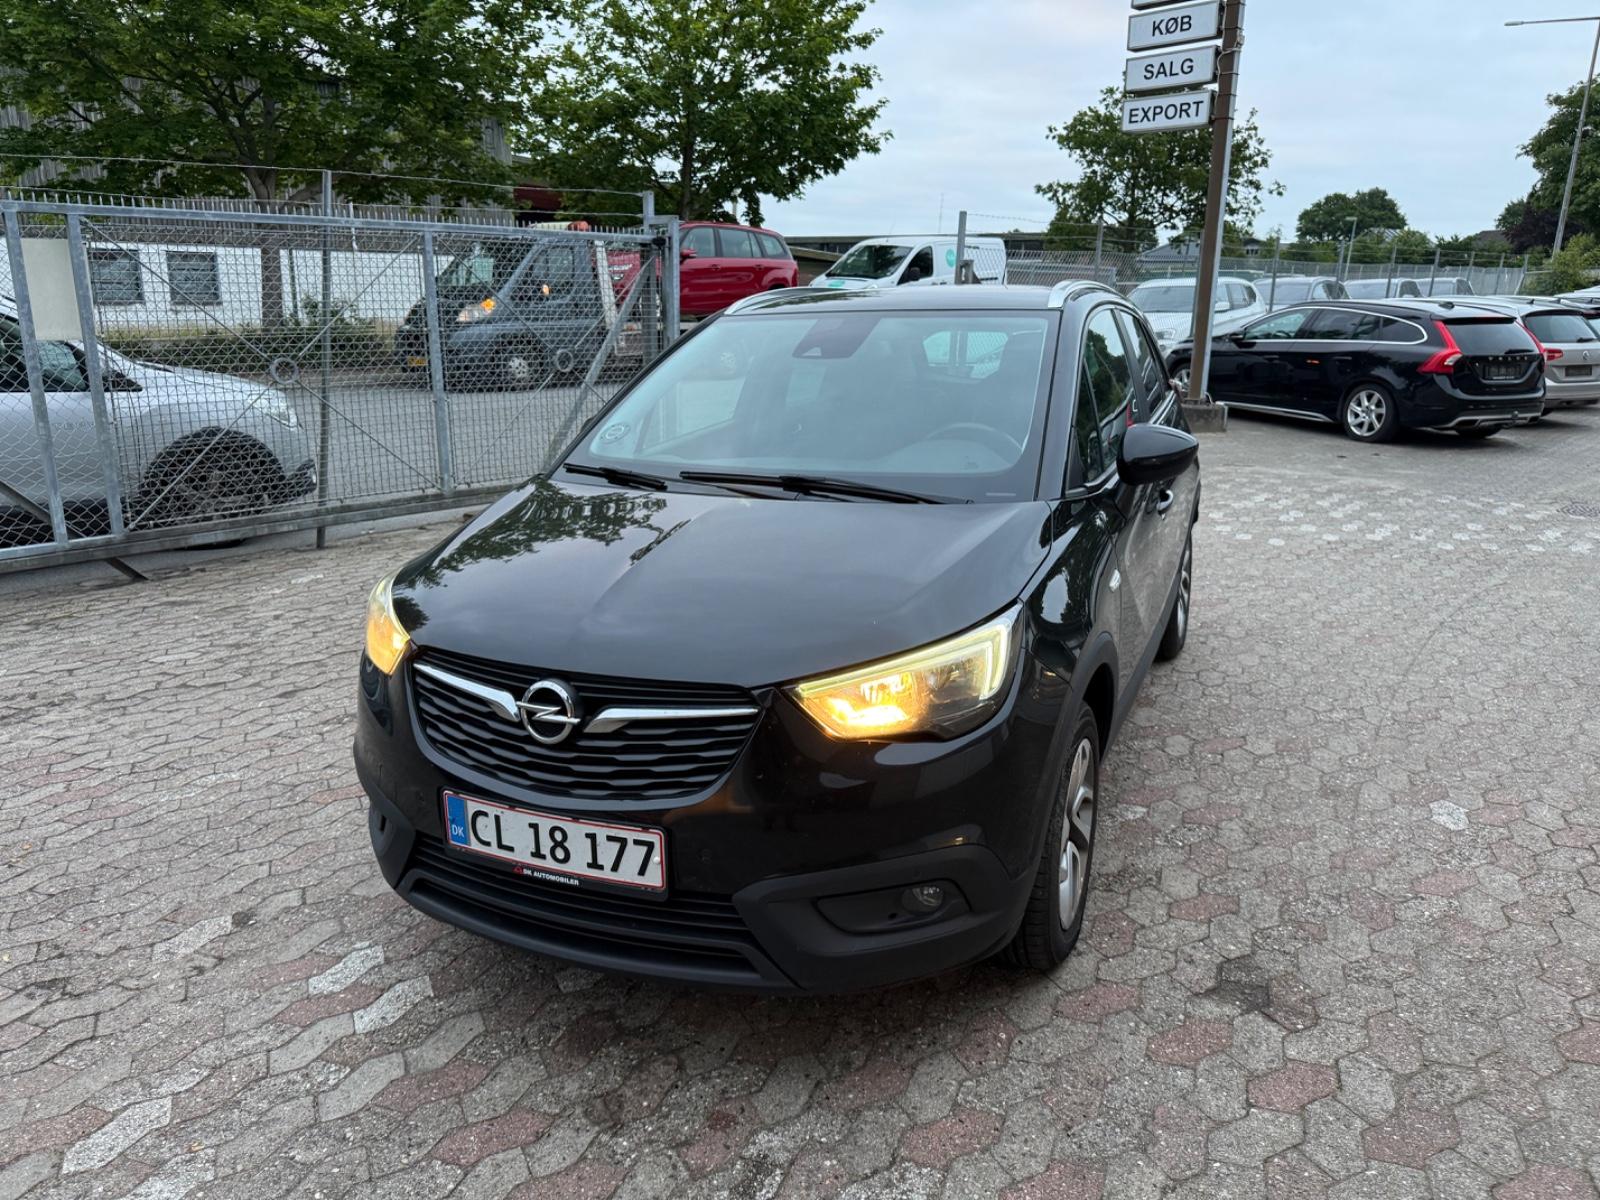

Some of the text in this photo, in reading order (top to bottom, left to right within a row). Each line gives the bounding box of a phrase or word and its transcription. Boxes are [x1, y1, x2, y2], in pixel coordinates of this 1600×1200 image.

[1151, 15, 1192, 37] KØB
[1143, 58, 1194, 80] SALG
[1128, 100, 1204, 124] EXPORT
[451, 824, 465, 838] DK
[471, 810, 655, 877] CL 18 177
[533, 871, 579, 886] AUTOMOBILER
